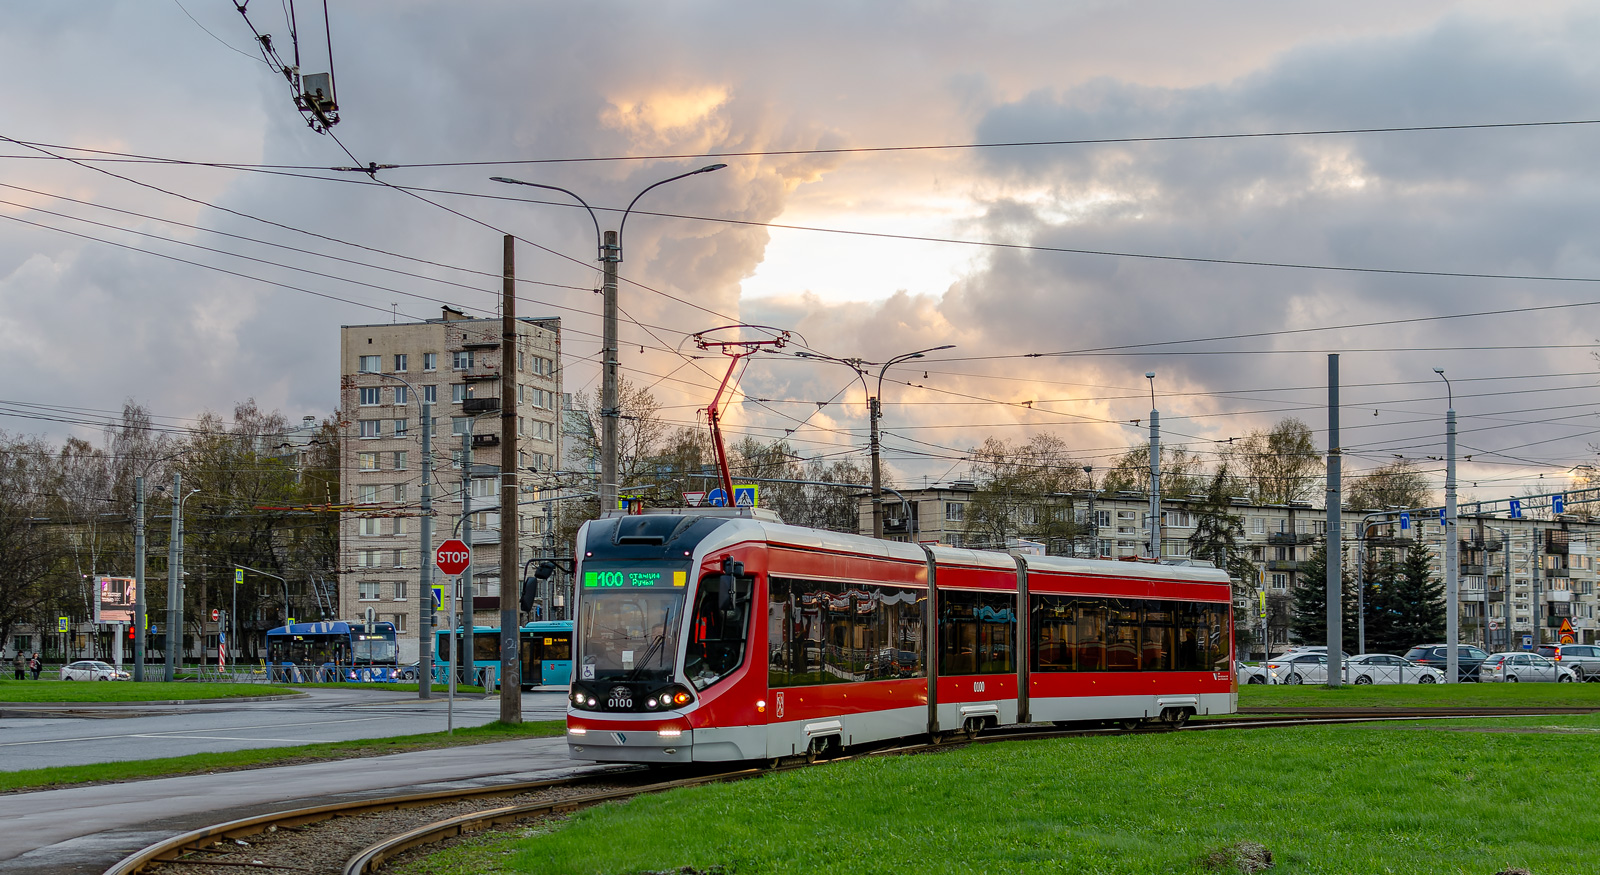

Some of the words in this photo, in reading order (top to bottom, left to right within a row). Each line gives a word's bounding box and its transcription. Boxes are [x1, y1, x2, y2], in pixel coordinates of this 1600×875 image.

[438, 551, 469, 563] STOP
[597, 571, 624, 587] 100
[628, 572, 661, 580] станция
[632, 578, 654, 587] Ручьи
[608, 698, 633, 708] 0100
